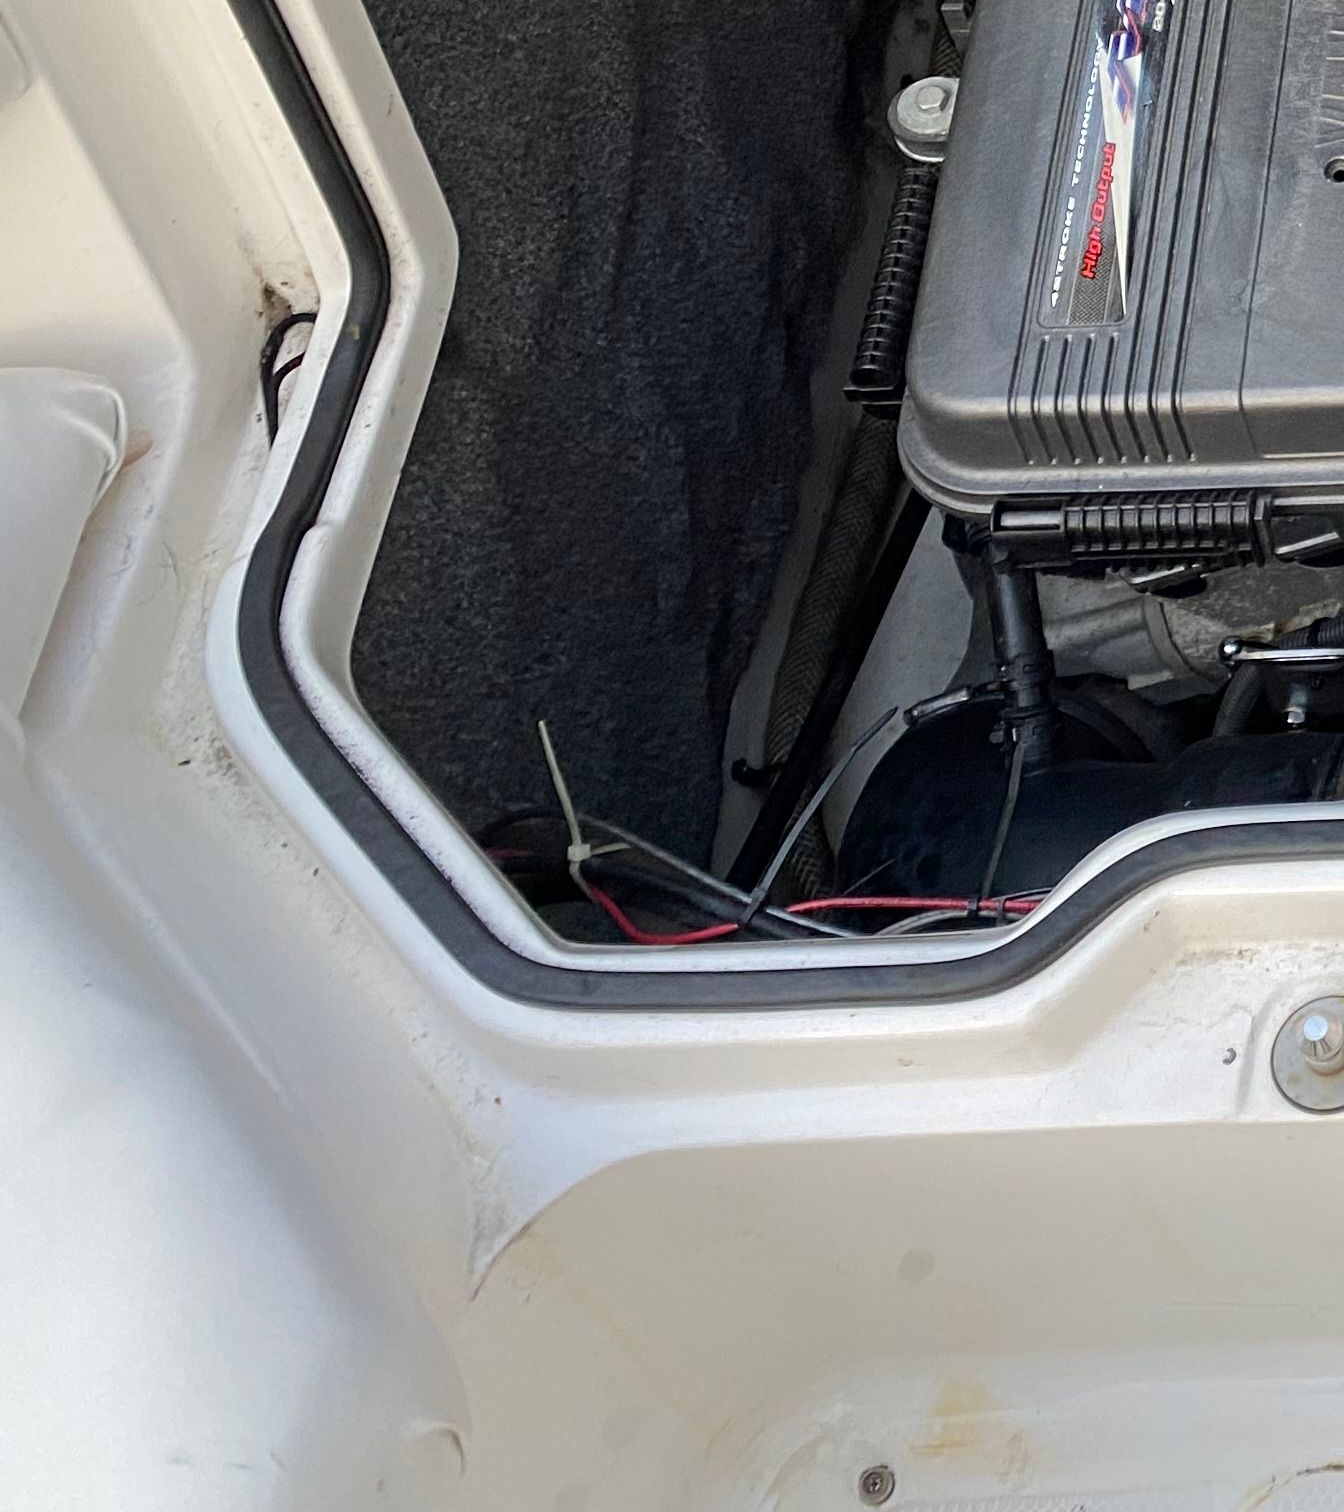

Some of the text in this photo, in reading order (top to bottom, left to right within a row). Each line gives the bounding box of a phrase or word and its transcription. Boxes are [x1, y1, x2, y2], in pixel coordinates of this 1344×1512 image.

[1070, 31, 1106, 187] TECHNOLOGY
[1080, 141, 1117, 279] High Output
